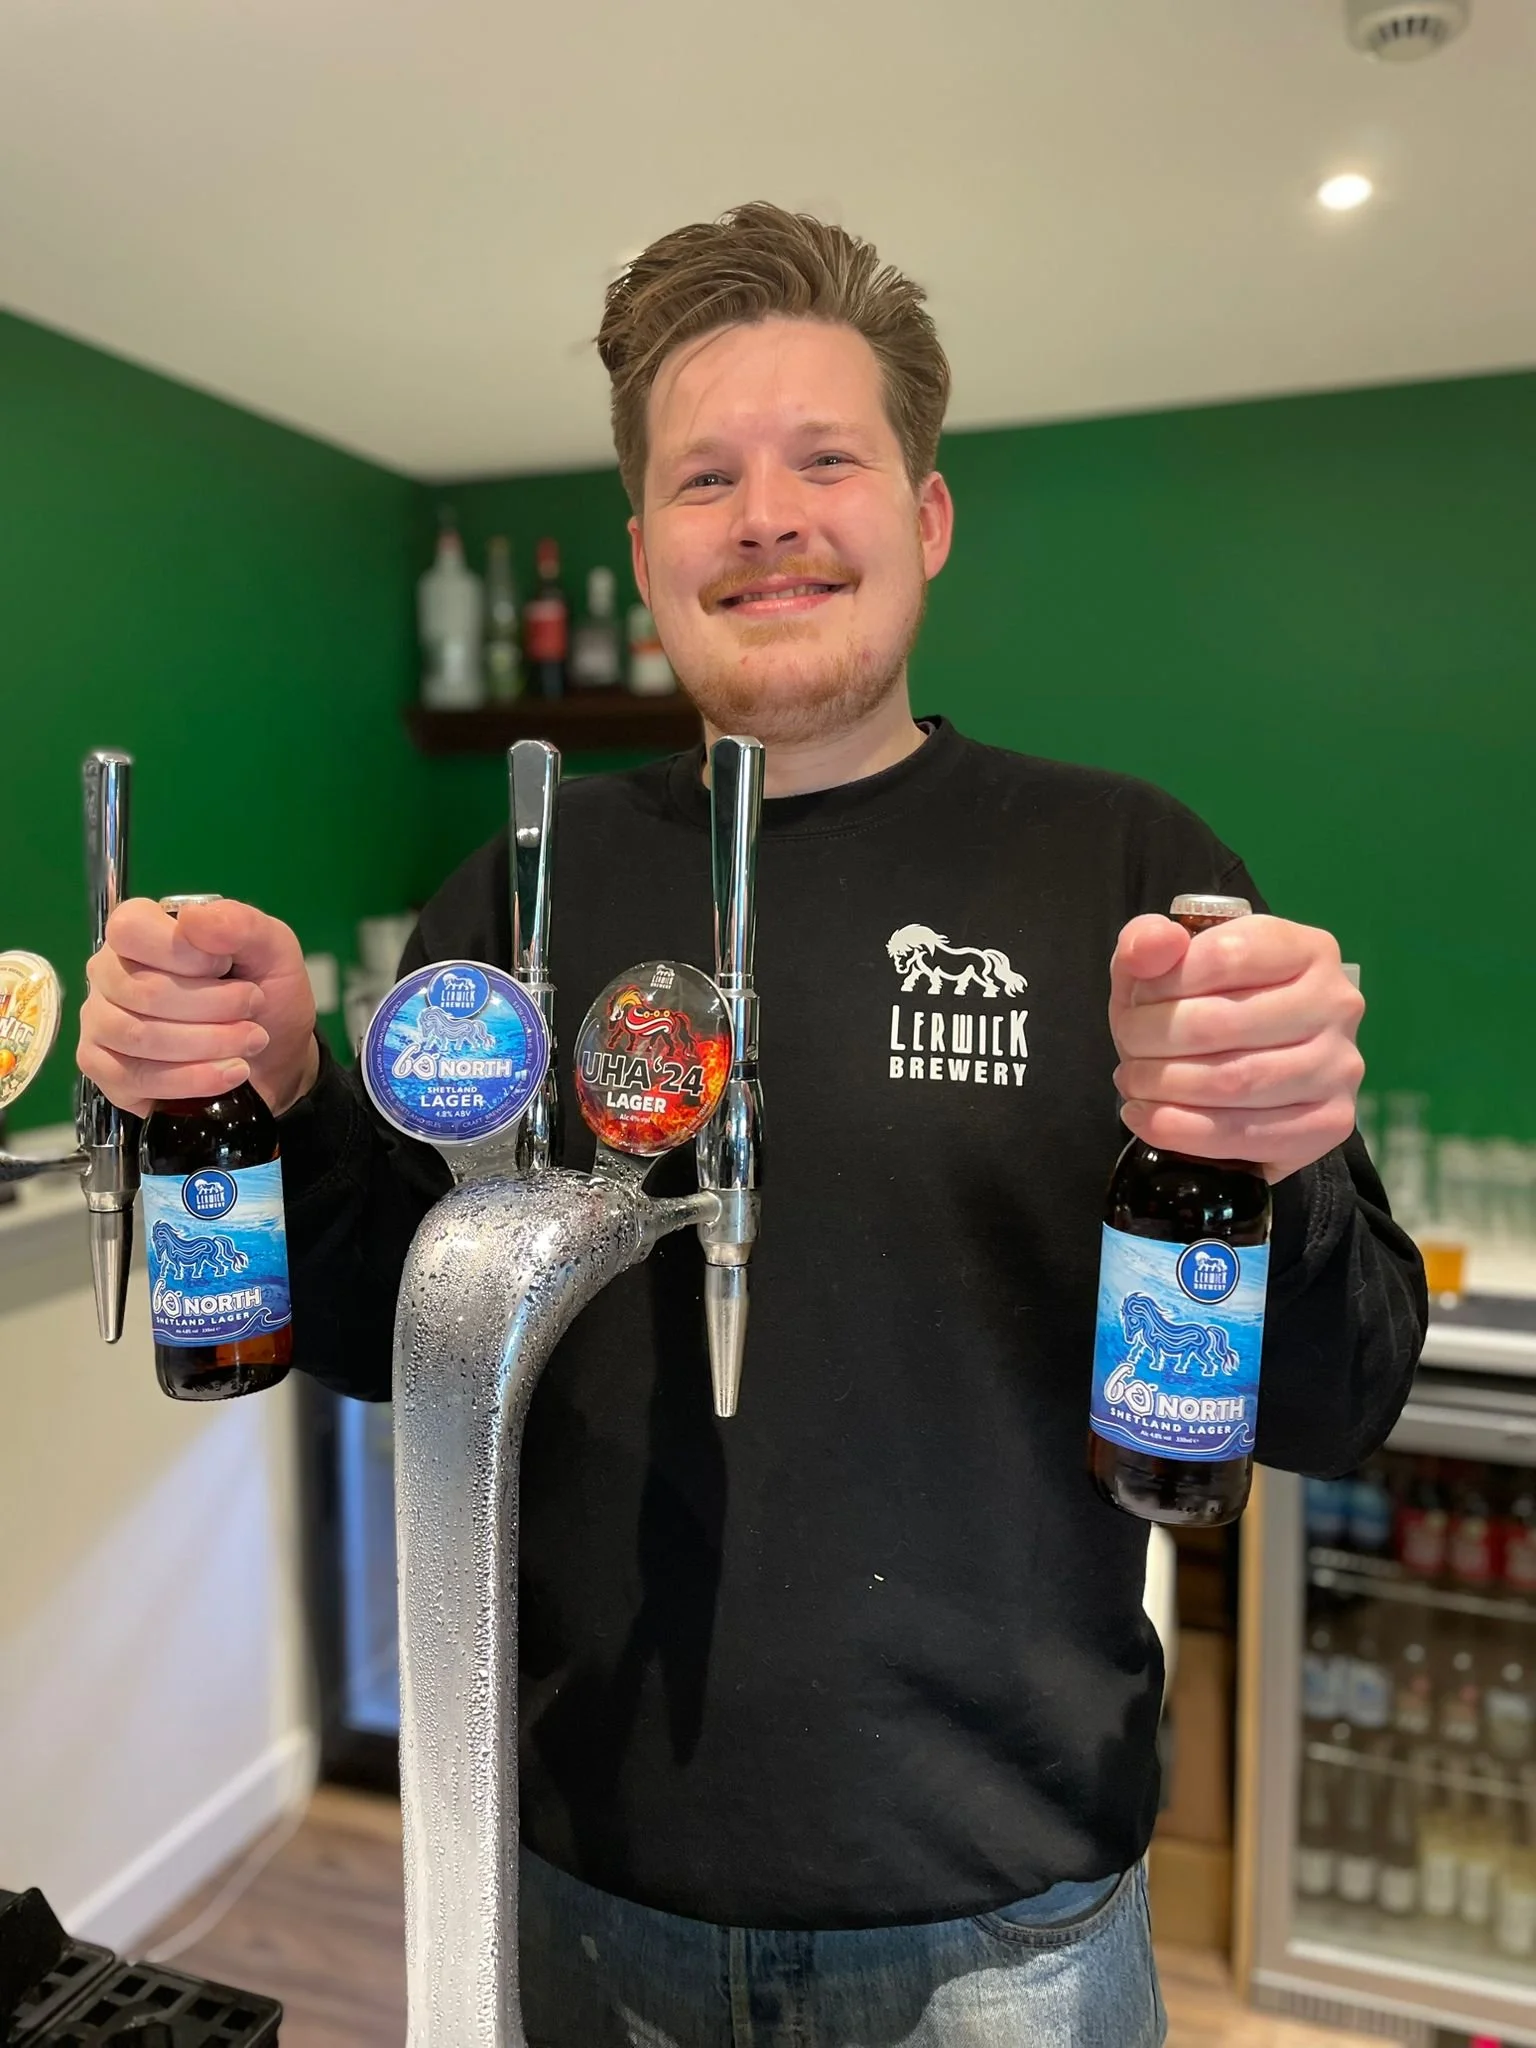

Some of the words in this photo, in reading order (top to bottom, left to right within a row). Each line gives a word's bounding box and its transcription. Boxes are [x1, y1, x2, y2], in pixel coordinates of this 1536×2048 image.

[890, 1005, 1029, 1057] LERWICK
[439, 1059, 512, 1078] NORTH
[889, 1056, 1027, 1086] BREWERY
[421, 1094, 484, 1107] LAGER
[427, 1086, 478, 1094] SHETLAND
[606, 1091, 667, 1113] LAGER
[183, 1287, 262, 1317] NORTH
[156, 1316, 205, 1326] SHETLAND
[211, 1312, 250, 1324] LAGER
[1156, 1394, 1245, 1421] NORTH
[1110, 1407, 1182, 1432] SHETLAND
[1188, 1424, 1232, 1434] LAGER
